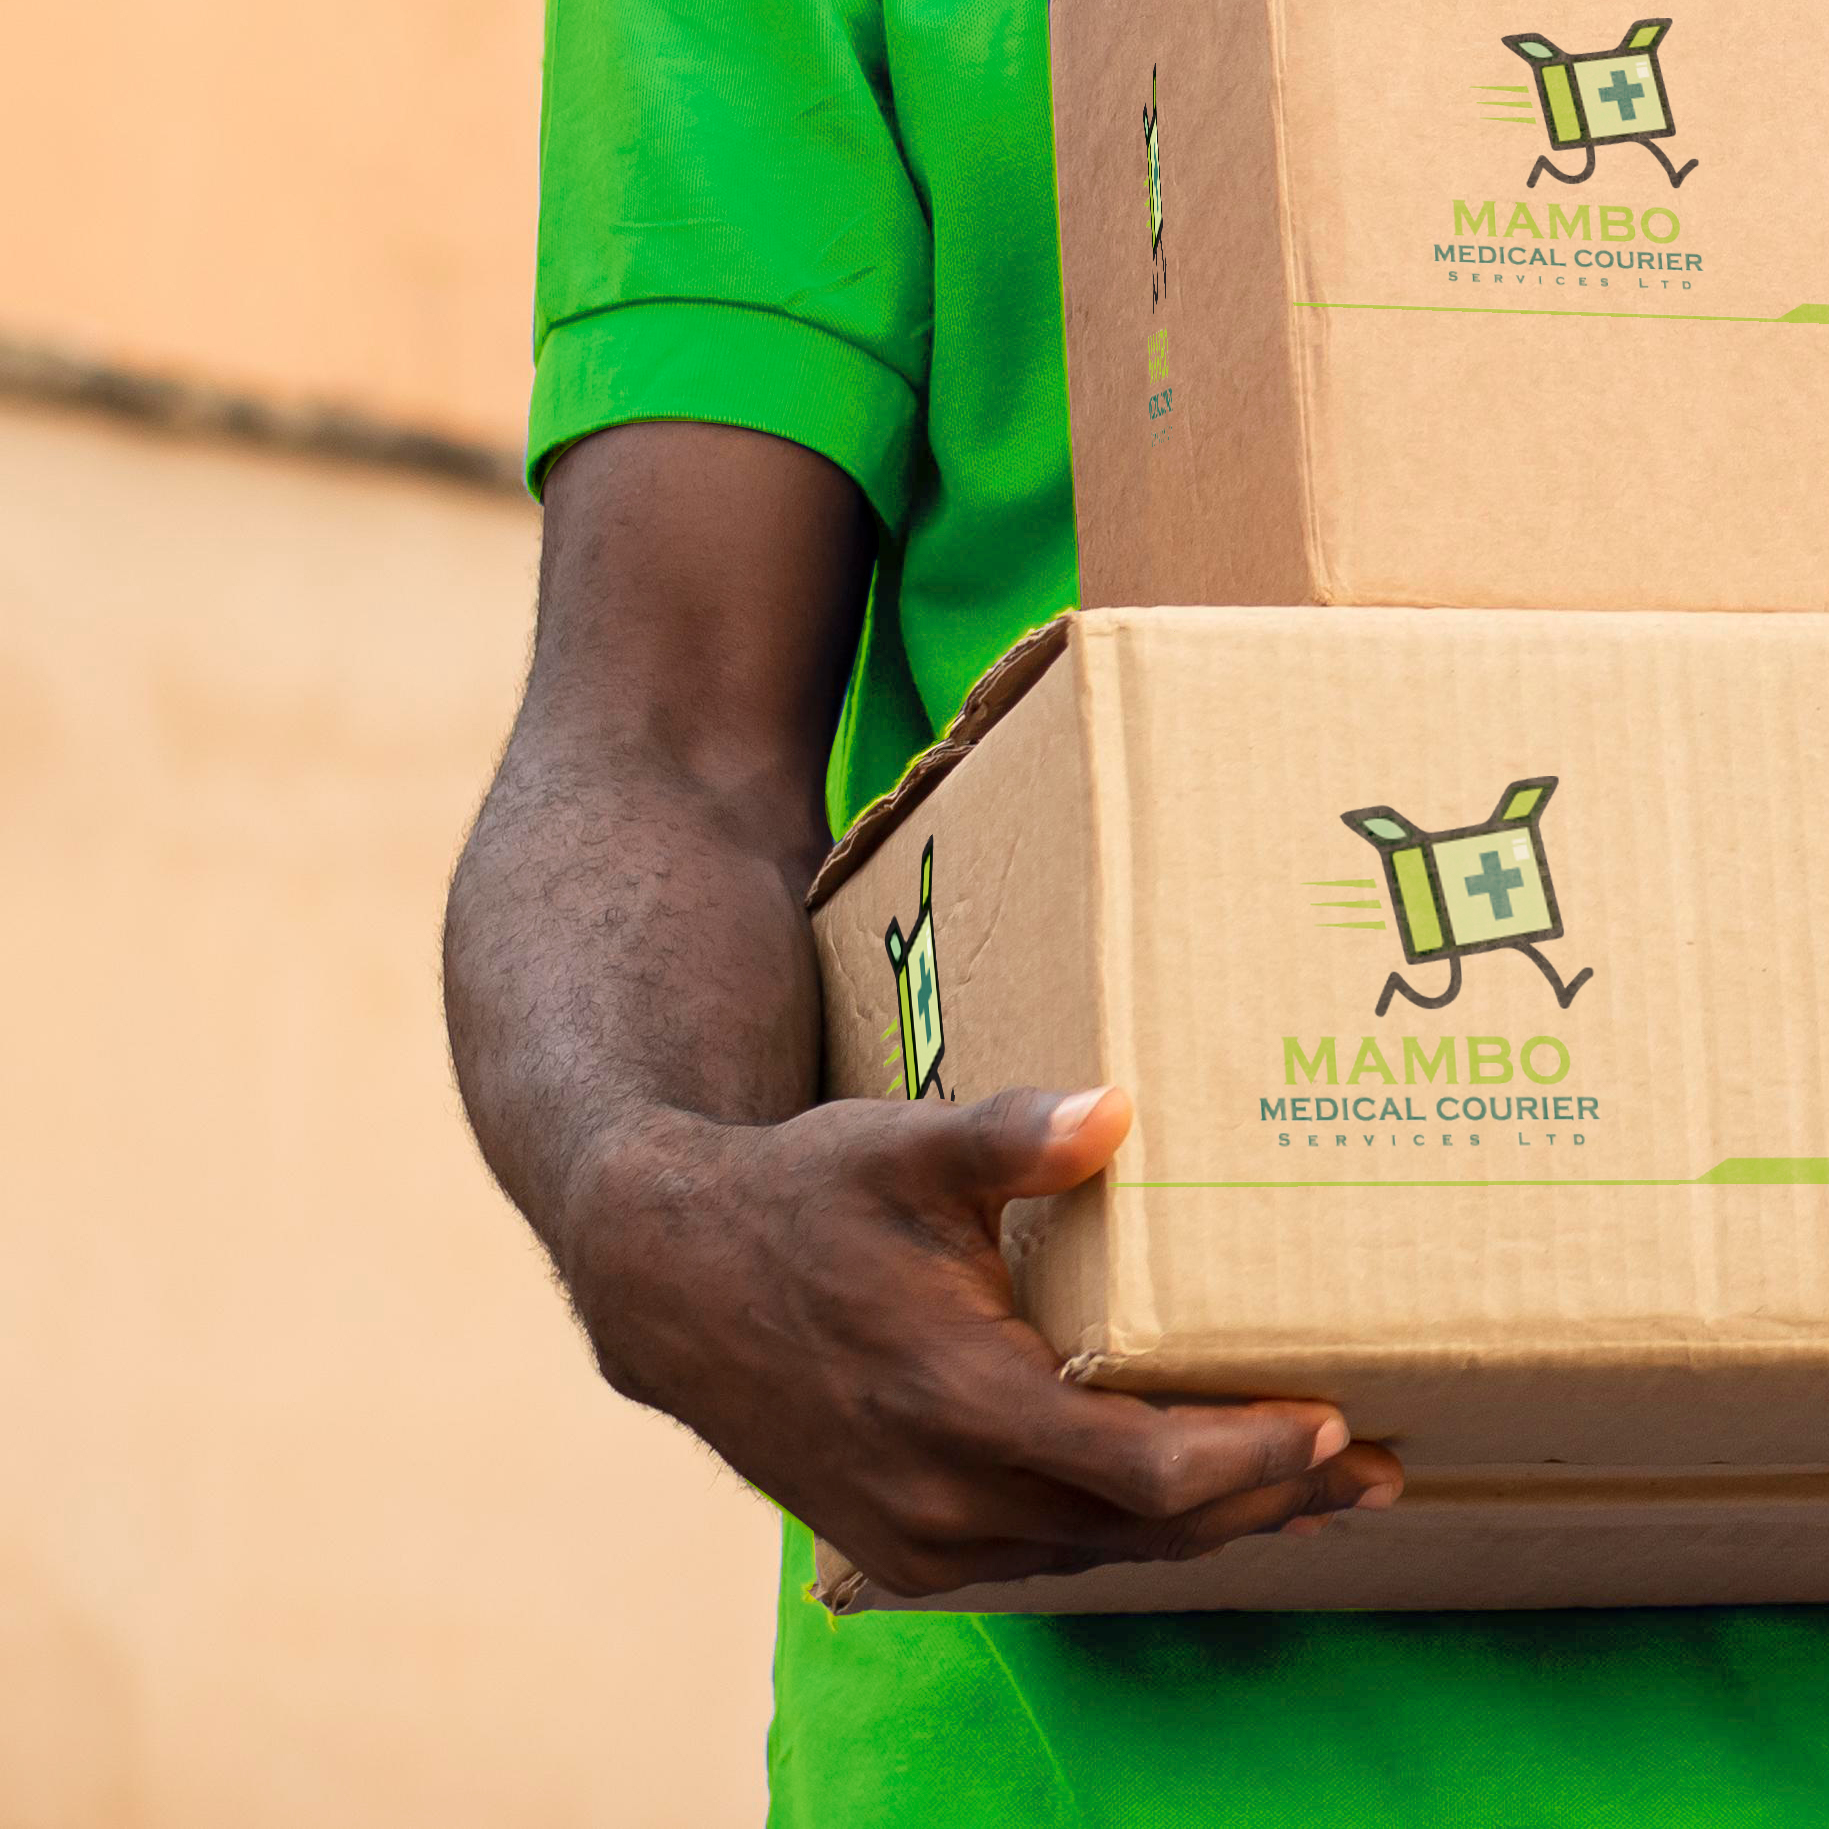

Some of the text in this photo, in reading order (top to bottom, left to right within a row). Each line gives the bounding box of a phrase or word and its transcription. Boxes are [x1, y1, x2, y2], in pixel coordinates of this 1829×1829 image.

[1452, 199, 1681, 244] MAMBO
[1433, 243, 1704, 272] MEDICAL COURIER
[1282, 1035, 1571, 1086] MAMBO
[1259, 1096, 1601, 1122] MEDICAL COURIER
